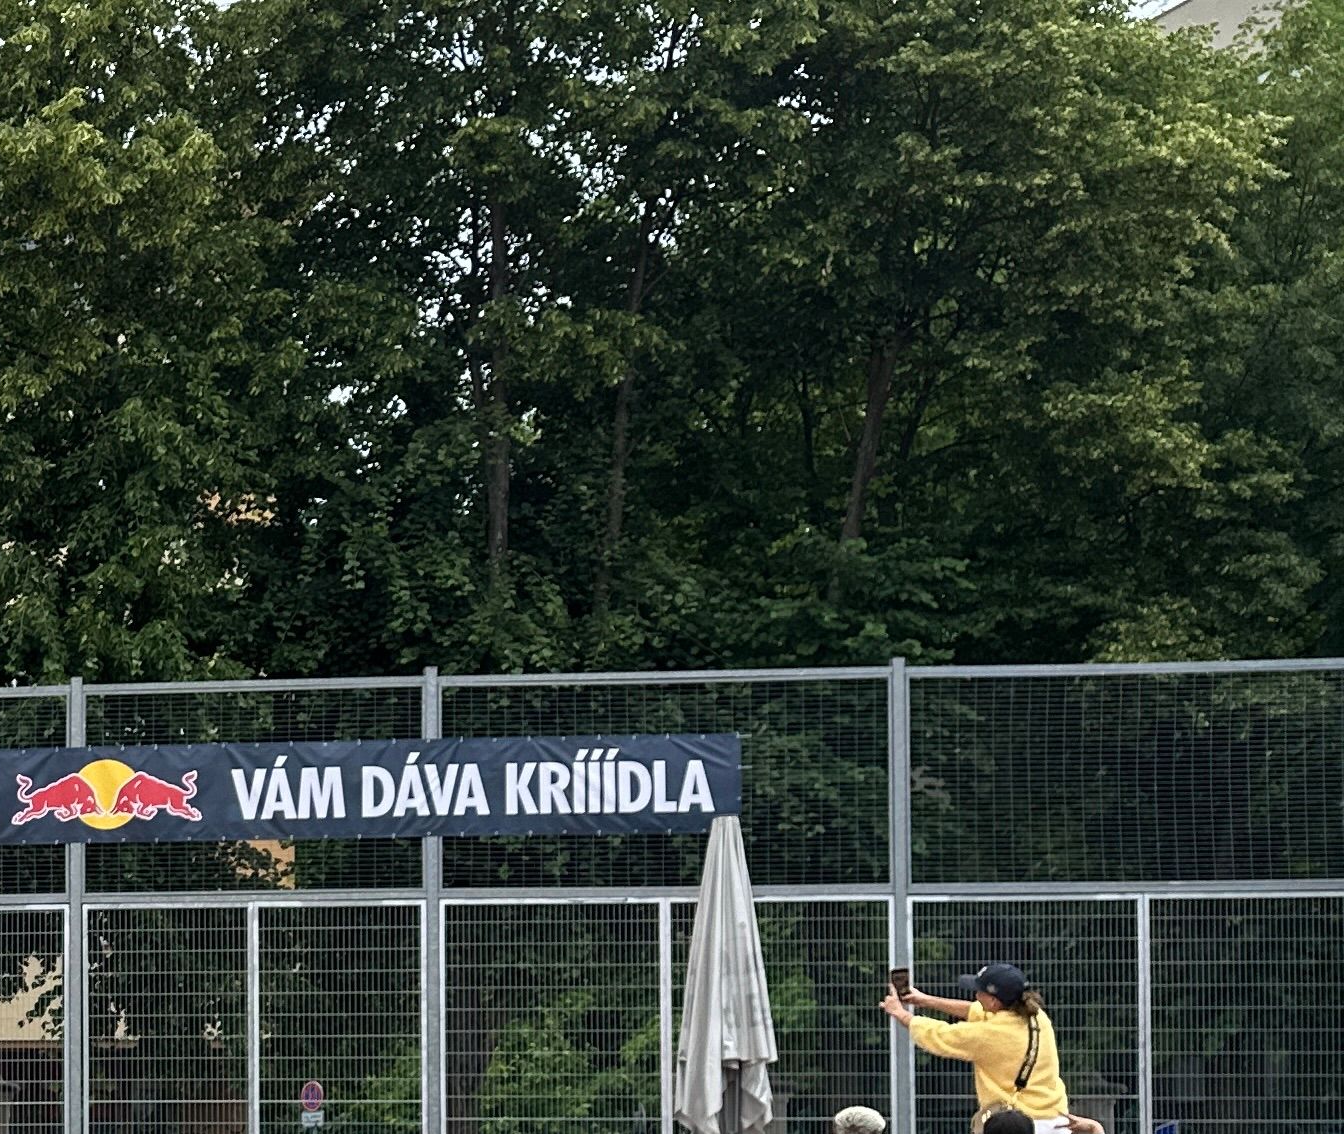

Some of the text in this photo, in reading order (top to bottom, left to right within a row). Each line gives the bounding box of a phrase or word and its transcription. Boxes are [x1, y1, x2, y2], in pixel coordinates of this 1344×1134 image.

[231, 755, 346, 820] VÁM
[361, 752, 490, 818] DÁVA
[505, 748, 716, 815] KRÍÍÍDLA
